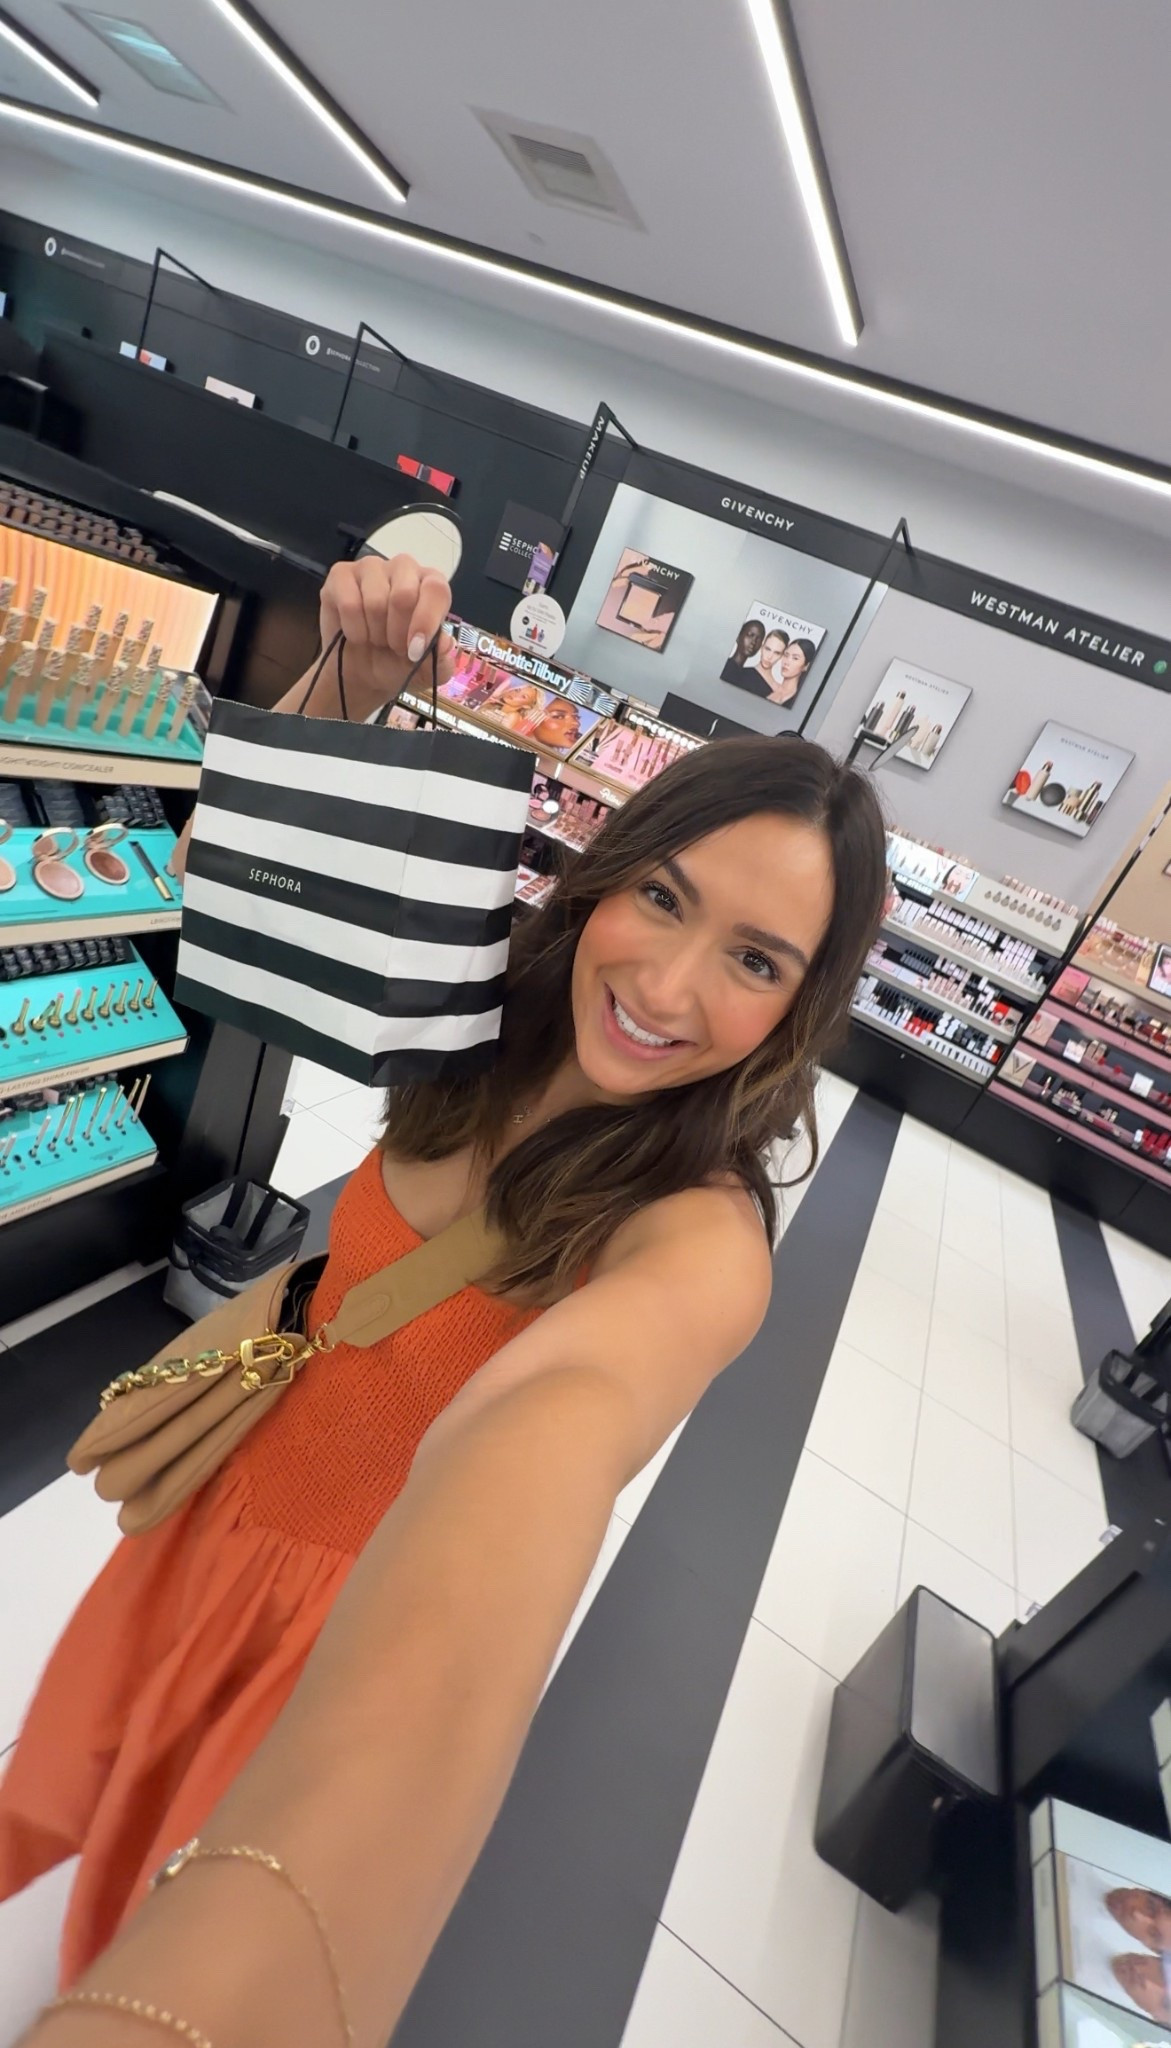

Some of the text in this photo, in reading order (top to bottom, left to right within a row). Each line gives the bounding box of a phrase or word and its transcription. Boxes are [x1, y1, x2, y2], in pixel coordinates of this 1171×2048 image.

[580, 415, 605, 480] MAKEUP
[721, 497, 794, 531] GIVENCHY
[510, 545, 534, 559] COLLEC
[511, 538, 540, 555] SEPHO
[760, 608, 813, 634] GIVENCHY
[970, 590, 1145, 667] WESTMAN ATELIER
[248, 867, 301, 894] SEPHORA
